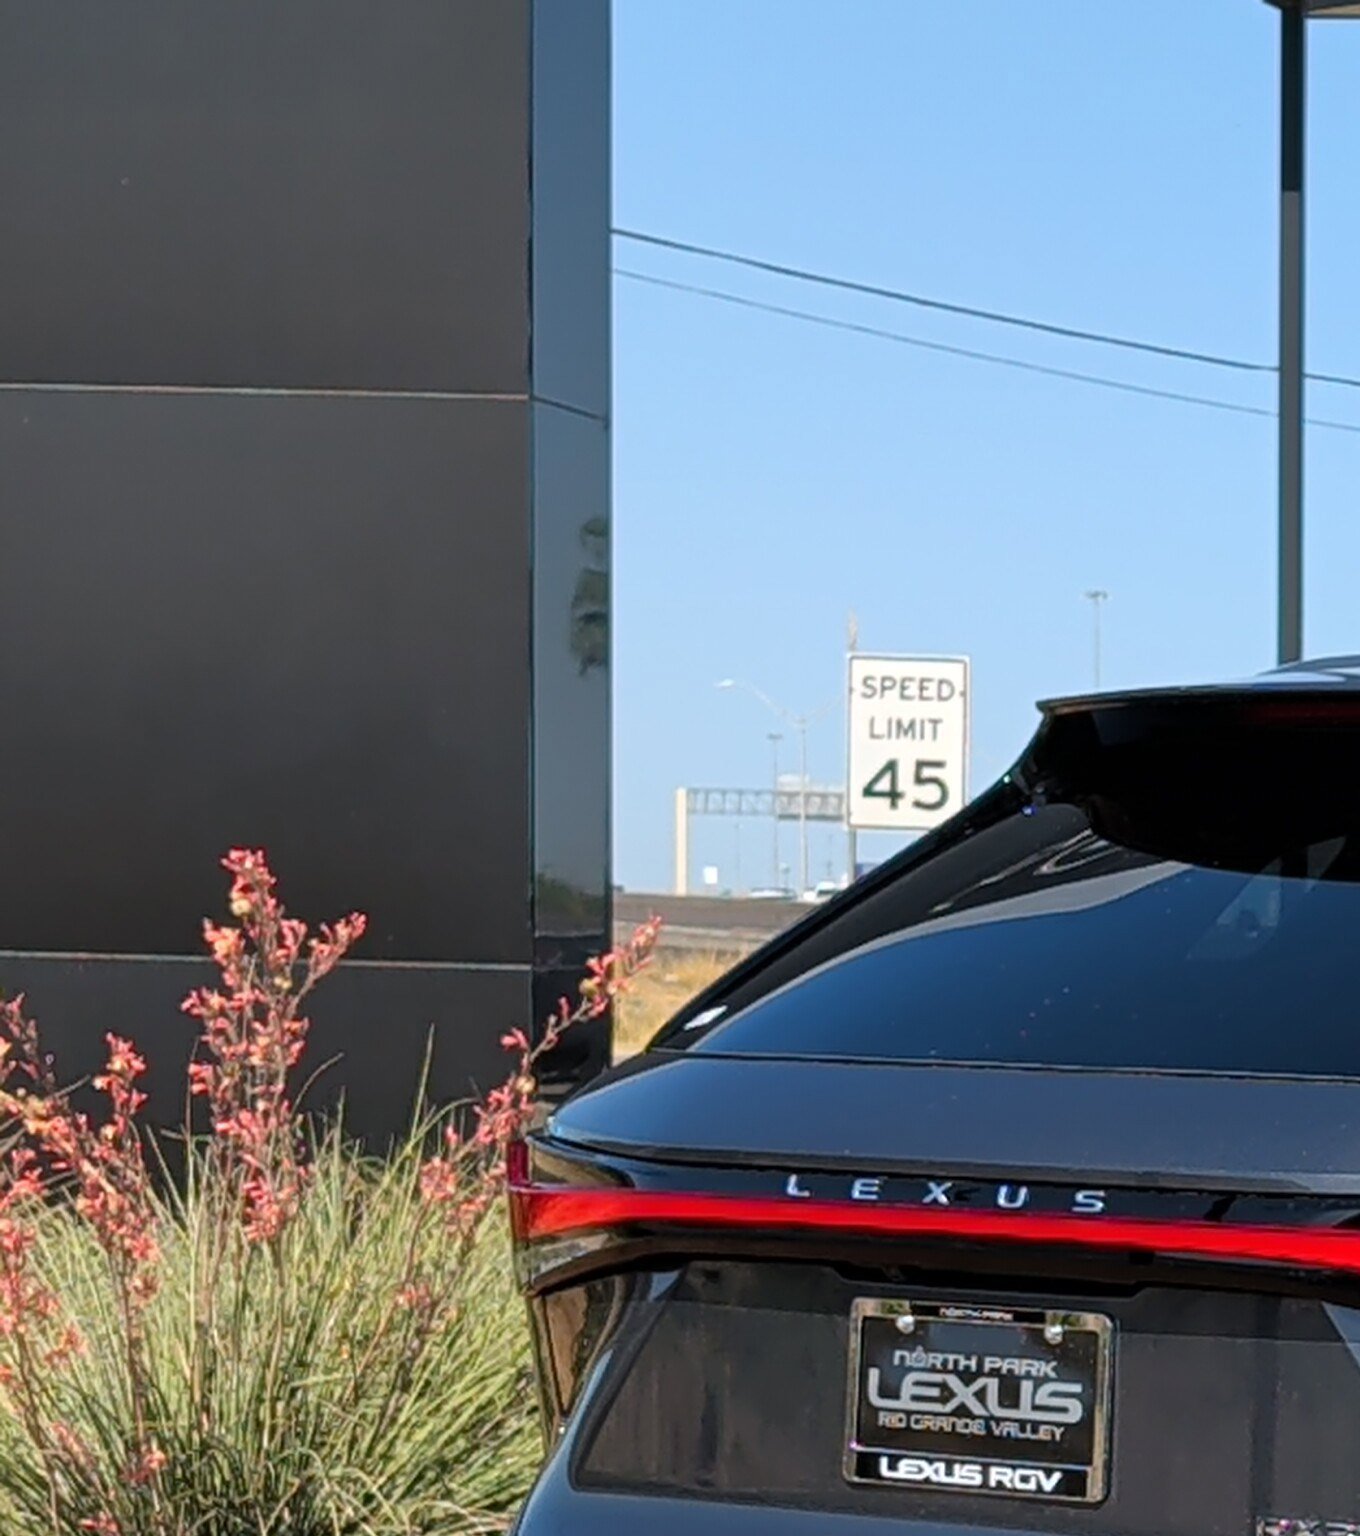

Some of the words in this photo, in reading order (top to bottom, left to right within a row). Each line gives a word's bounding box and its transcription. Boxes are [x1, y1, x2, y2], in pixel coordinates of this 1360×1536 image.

[861, 675, 955, 702] SPEED
[868, 716, 943, 742] LIMIT
[862, 758, 949, 811] 45
[786, 1173, 1107, 1214] LEXUS
[893, 1346, 977, 1372] NORTH
[983, 1356, 1058, 1378] PARK
[867, 1366, 1083, 1424] LEXUS
[877, 1410, 907, 1428] RIO
[910, 1414, 987, 1436] GRANDE
[990, 1421, 1065, 1442] VALLEY
[879, 1456, 983, 1487] LEXUS
[989, 1465, 1063, 1491] RGV
